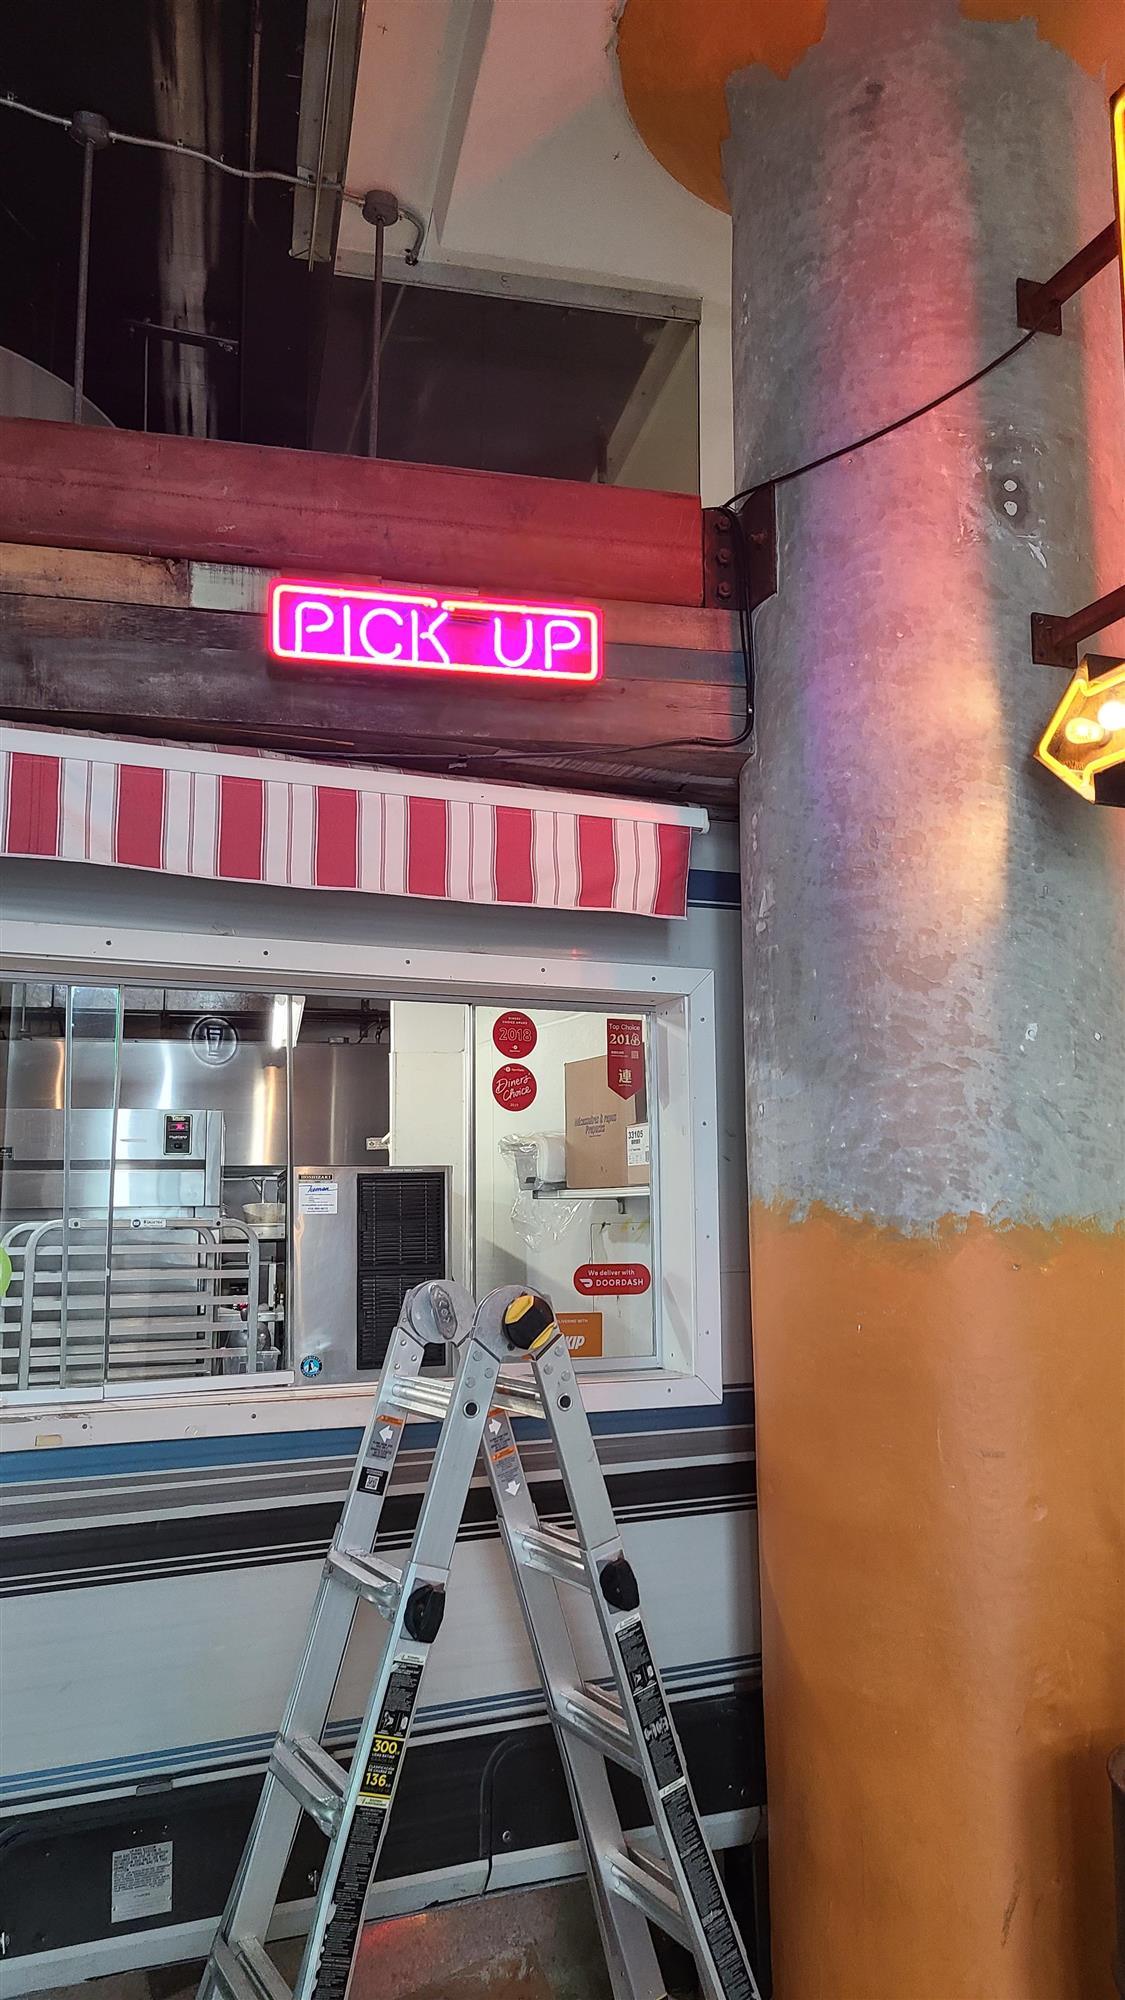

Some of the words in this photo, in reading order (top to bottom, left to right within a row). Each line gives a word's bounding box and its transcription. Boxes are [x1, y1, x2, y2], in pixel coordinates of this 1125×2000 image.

[294, 600, 450, 666] PICK
[493, 616, 582, 669] UP
[499, 1027, 532, 1042] 2018
[503, 1086, 532, 1102] Choice
[628, 1130, 644, 1139] 33105
[595, 1279, 644, 1287] DOORDASH
[565, 1335, 586, 1349] KIP
[373, 1739, 398, 1755] 300
[365, 1772, 386, 1787] 136
